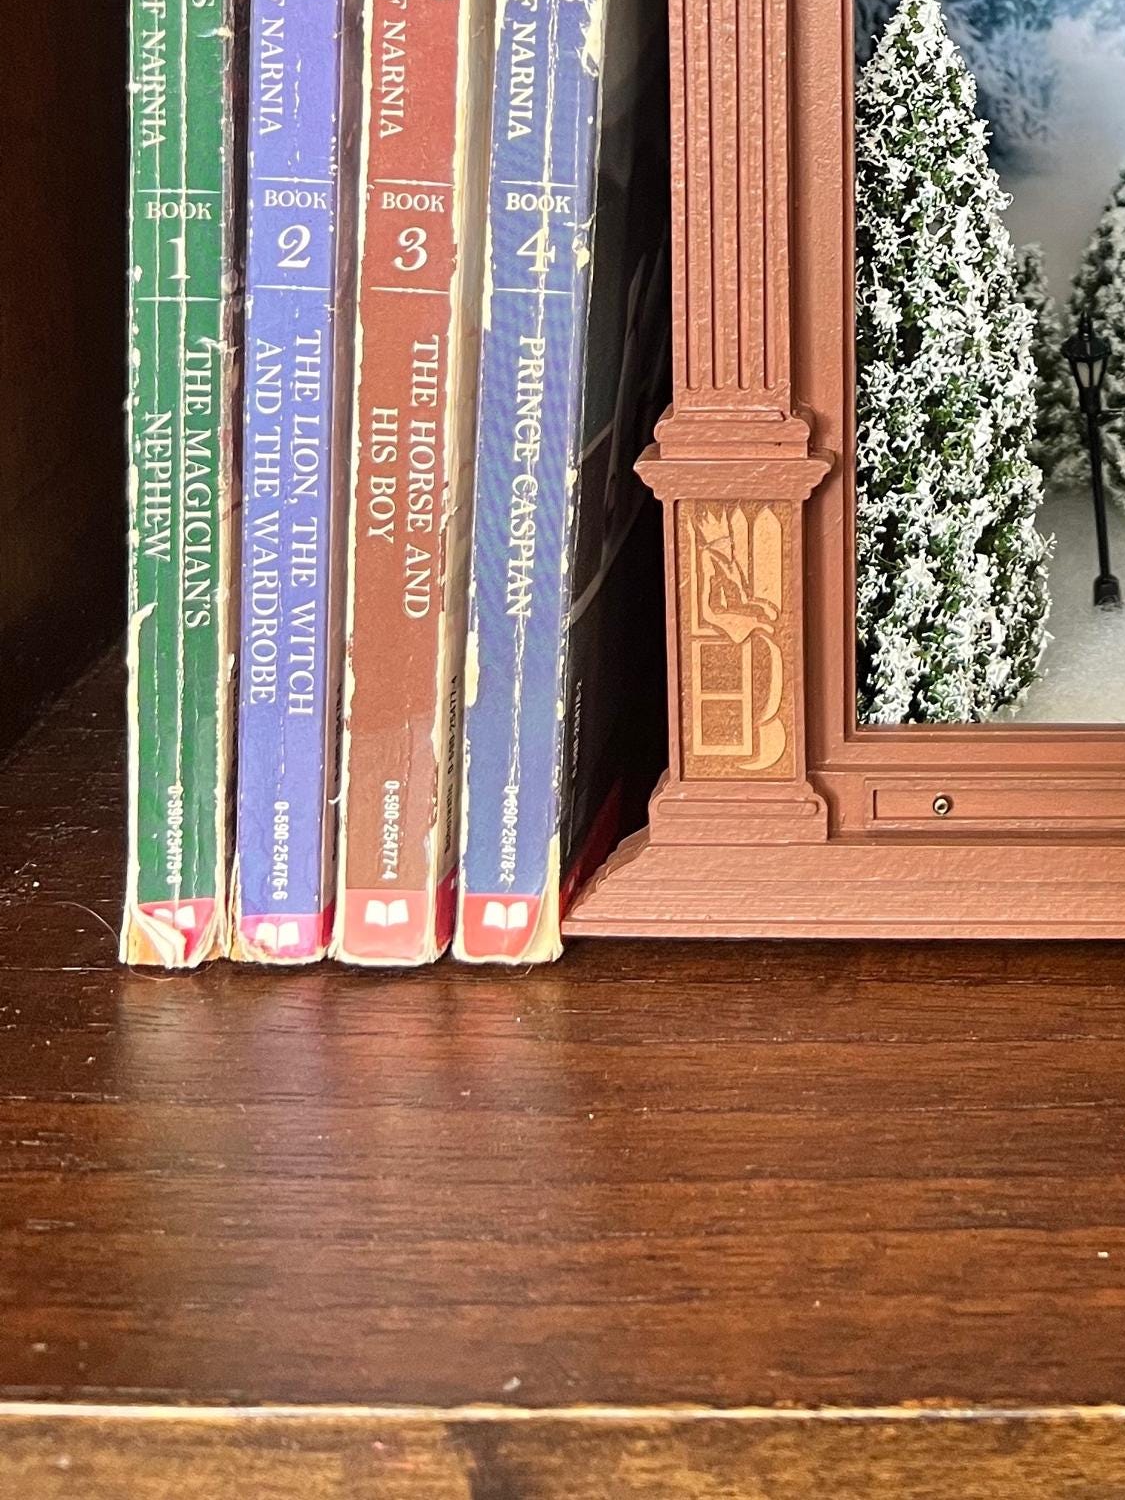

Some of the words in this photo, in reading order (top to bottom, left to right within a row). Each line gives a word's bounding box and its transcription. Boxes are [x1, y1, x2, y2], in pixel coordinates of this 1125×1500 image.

[141, 31, 167, 148] NARNIA
[260, 18, 285, 136] NARNIA
[380, 21, 407, 138] NARNIA
[508, 22, 537, 140] NARNIA
[147, 201, 212, 221] BOOK
[264, 190, 328, 211] BOOK
[381, 192, 445, 213] BOOK
[505, 193, 571, 214] BOOK
[167, 236, 192, 280] 1
[277, 225, 312, 269] 2
[394, 227, 427, 271] 3
[517, 228, 556, 273] 4
[186, 349, 212, 416] THE
[255, 339, 282, 415] AND
[294, 331, 321, 397] THE
[412, 335, 439, 408] THE
[514, 336, 546, 462] PRINCE
[253, 427, 281, 498] THE
[286, 411, 319, 503] LION,
[371, 407, 398, 459] HIS
[144, 410, 173, 562] NEPHEW
[367, 471, 398, 543] BOY
[407, 420, 437, 534] HORSE
[184, 427, 212, 628] MAGICIAN'S
[291, 517, 321, 588] THE
[505, 474, 538, 619] CASPIAN
[248, 512, 280, 705] WARDROBE
[403, 545, 432, 620] AND
[287, 602, 316, 716] WITCH
[273, 801, 289, 900] 0-590-25476-6
[383, 780, 400, 880] 0-590-25477-4
